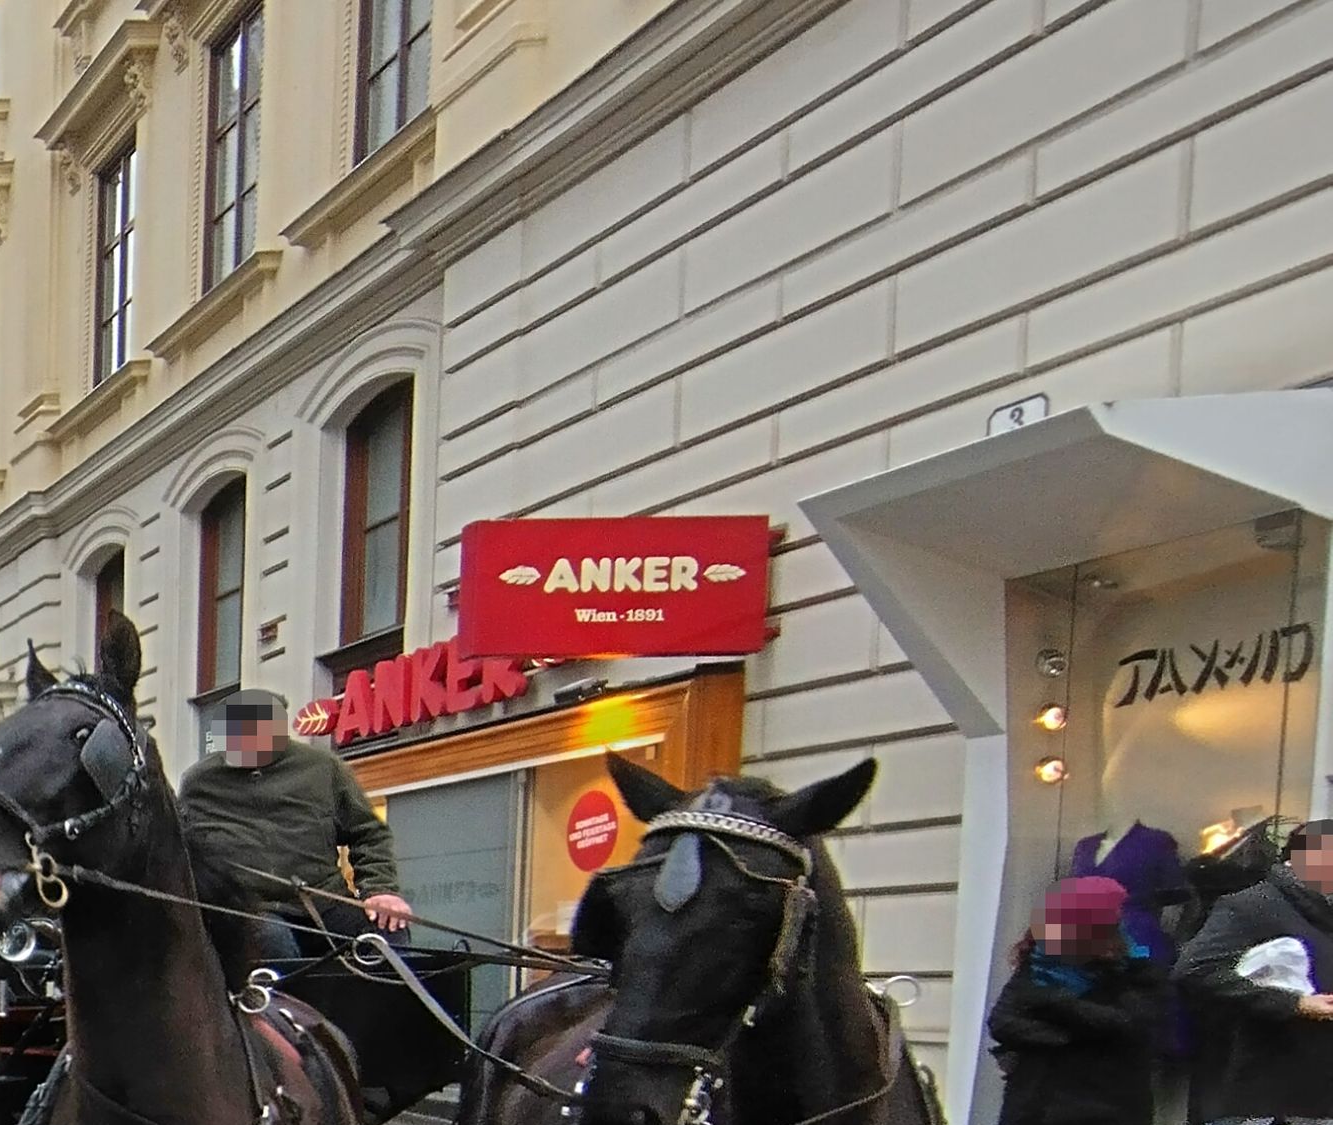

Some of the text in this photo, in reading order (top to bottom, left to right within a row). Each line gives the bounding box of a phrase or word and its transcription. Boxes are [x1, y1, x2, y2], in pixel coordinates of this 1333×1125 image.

[543, 556, 699, 594] ANKER
[574, 608, 665, 623] Wien 1891
